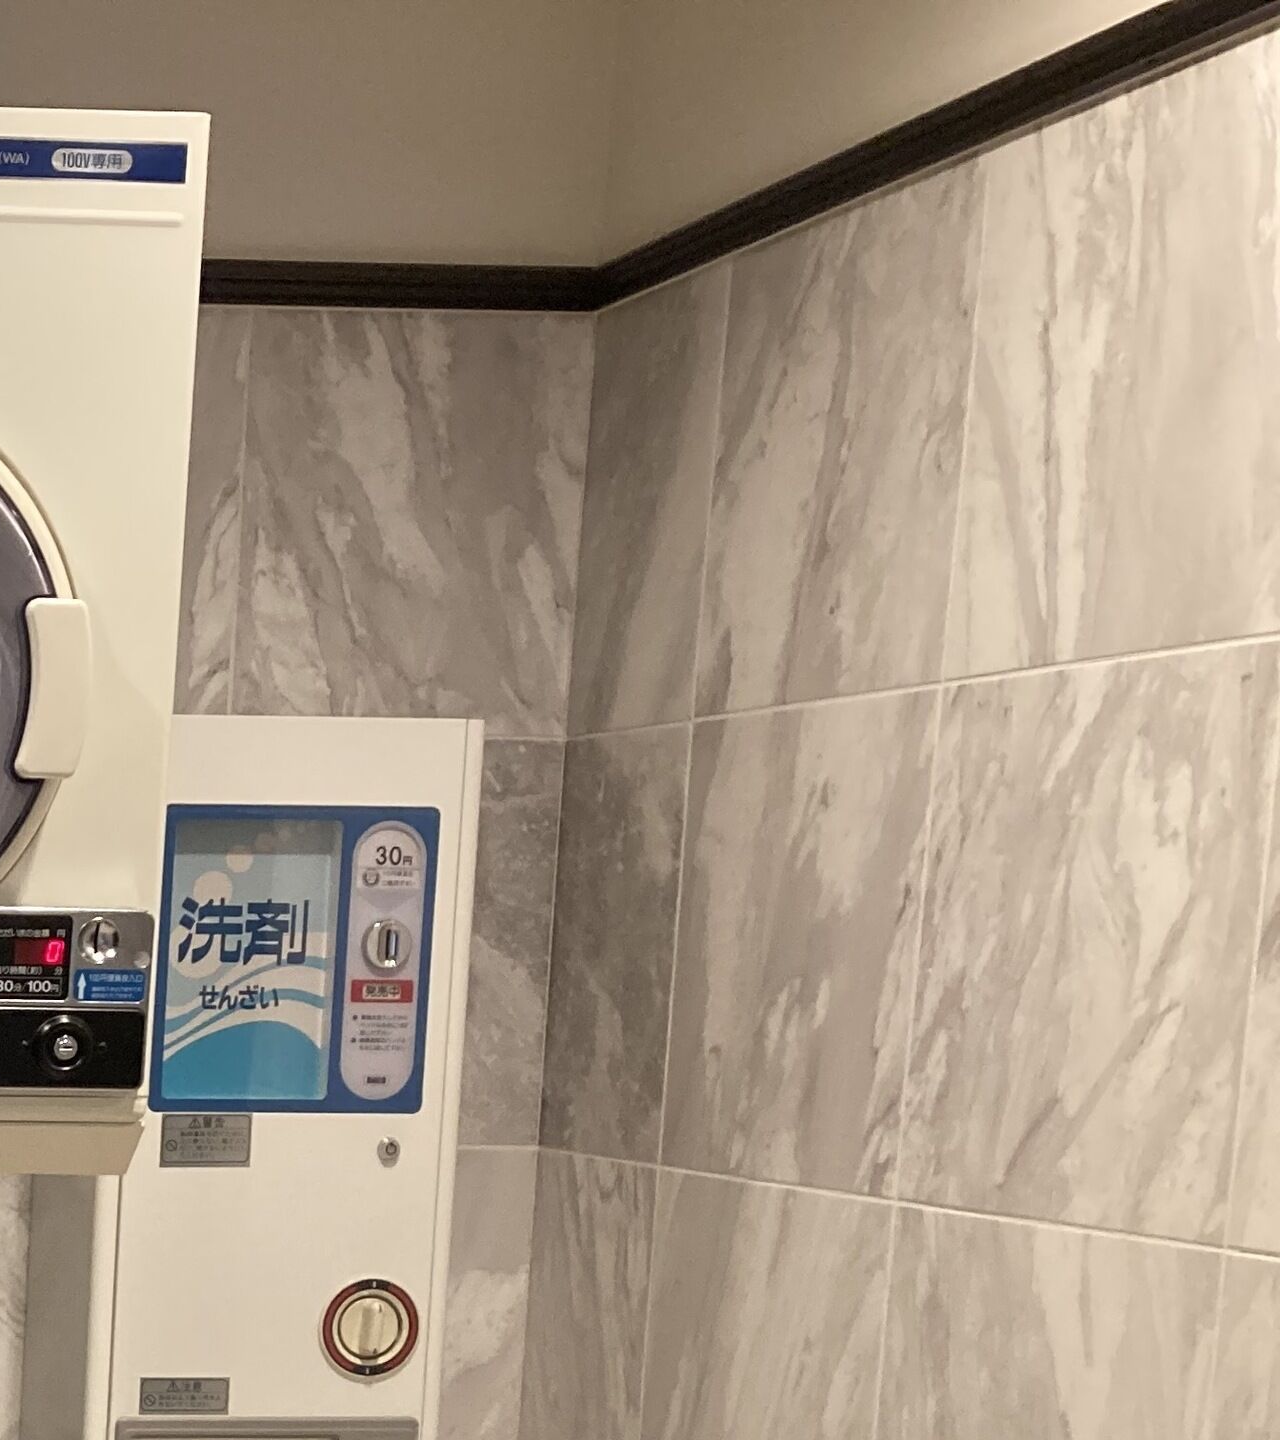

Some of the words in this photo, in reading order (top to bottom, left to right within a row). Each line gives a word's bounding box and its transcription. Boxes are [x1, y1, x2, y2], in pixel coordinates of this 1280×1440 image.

[60, 150, 123, 170] 100V専用
[376, 846, 413, 866] 30円
[178, 897, 310, 965] 洗剤
[47, 941, 65, 962] 0
[200, 985, 279, 1010] せんざい
[365, 984, 401, 998] 発売中
